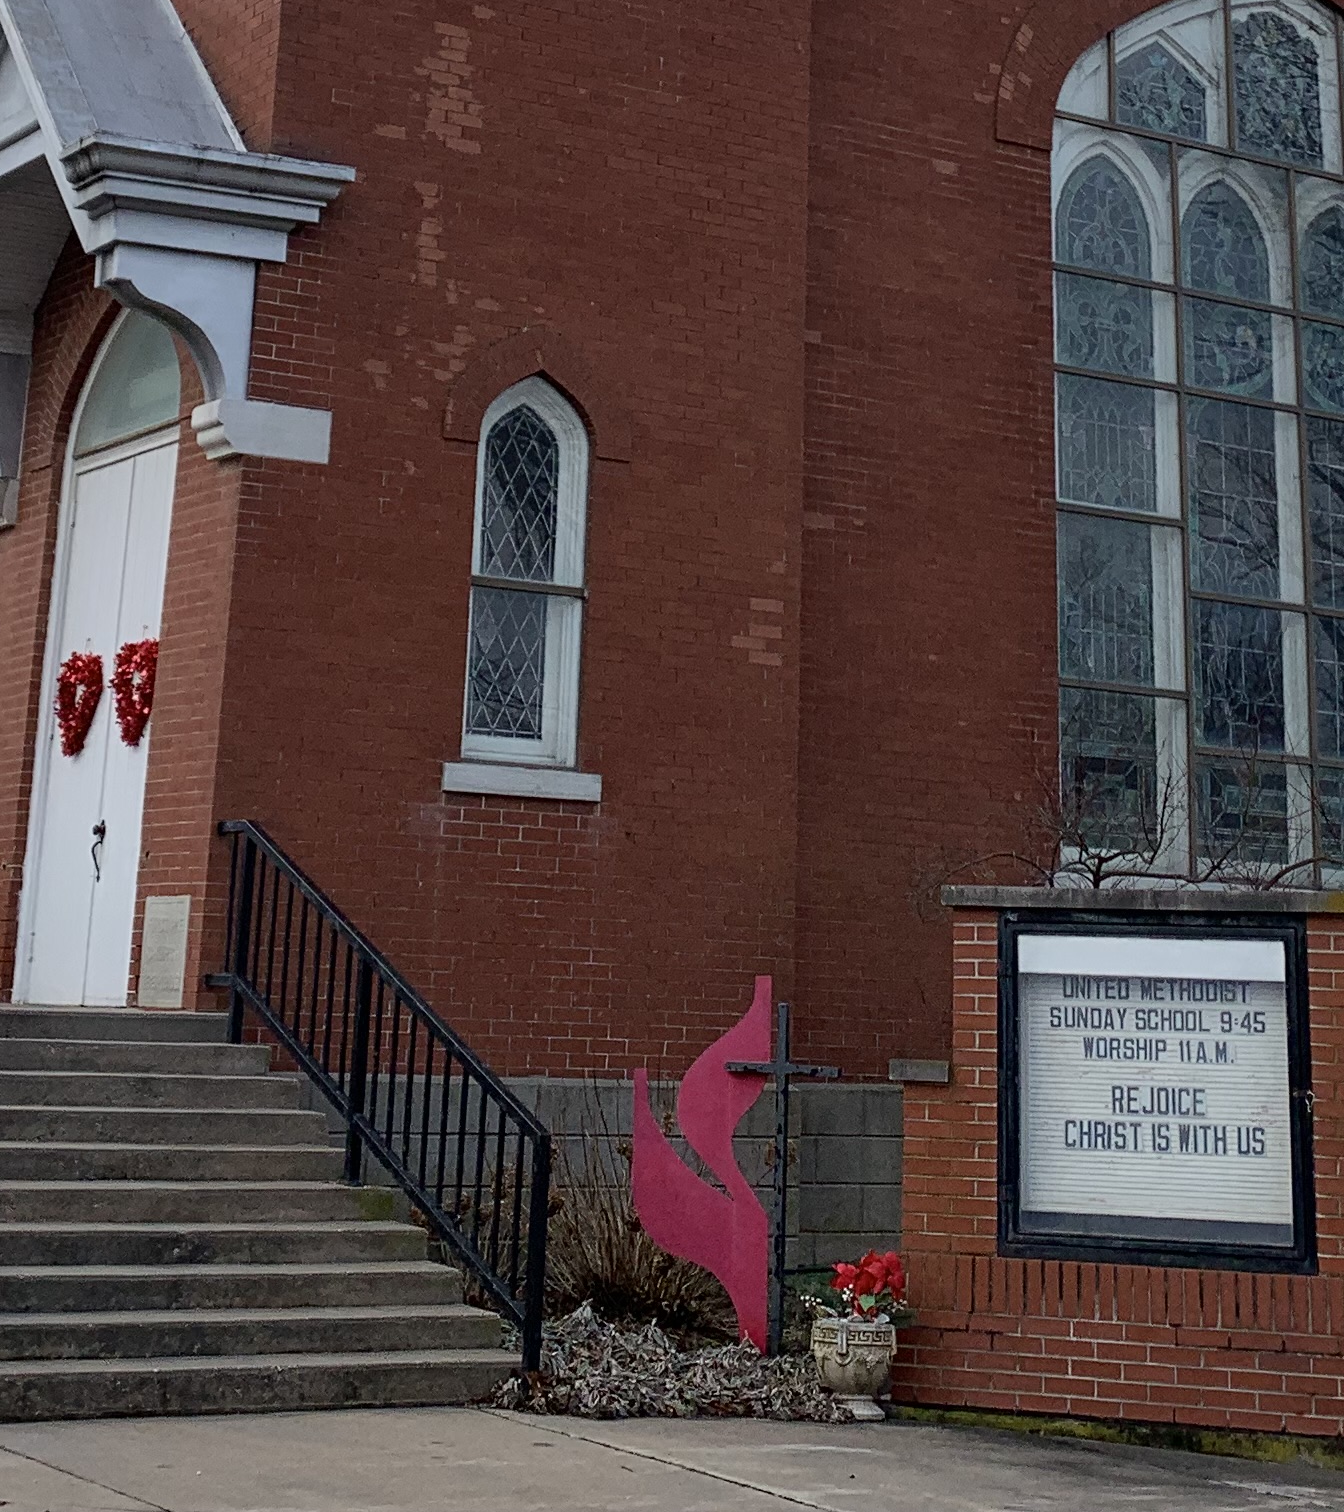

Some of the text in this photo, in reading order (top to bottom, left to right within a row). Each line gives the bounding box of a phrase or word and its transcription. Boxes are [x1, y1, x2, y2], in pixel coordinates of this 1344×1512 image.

[1062, 975, 1251, 1004] UNITED METHODIST
[1049, 1006, 1266, 1034] SUNDAY SCHOOL 9:45
[1082, 1036, 1167, 1061] WORSHIP
[1111, 1085, 1206, 1116] REJOICE
[1064, 1119, 1266, 1156] CHRIST IS WITH US
